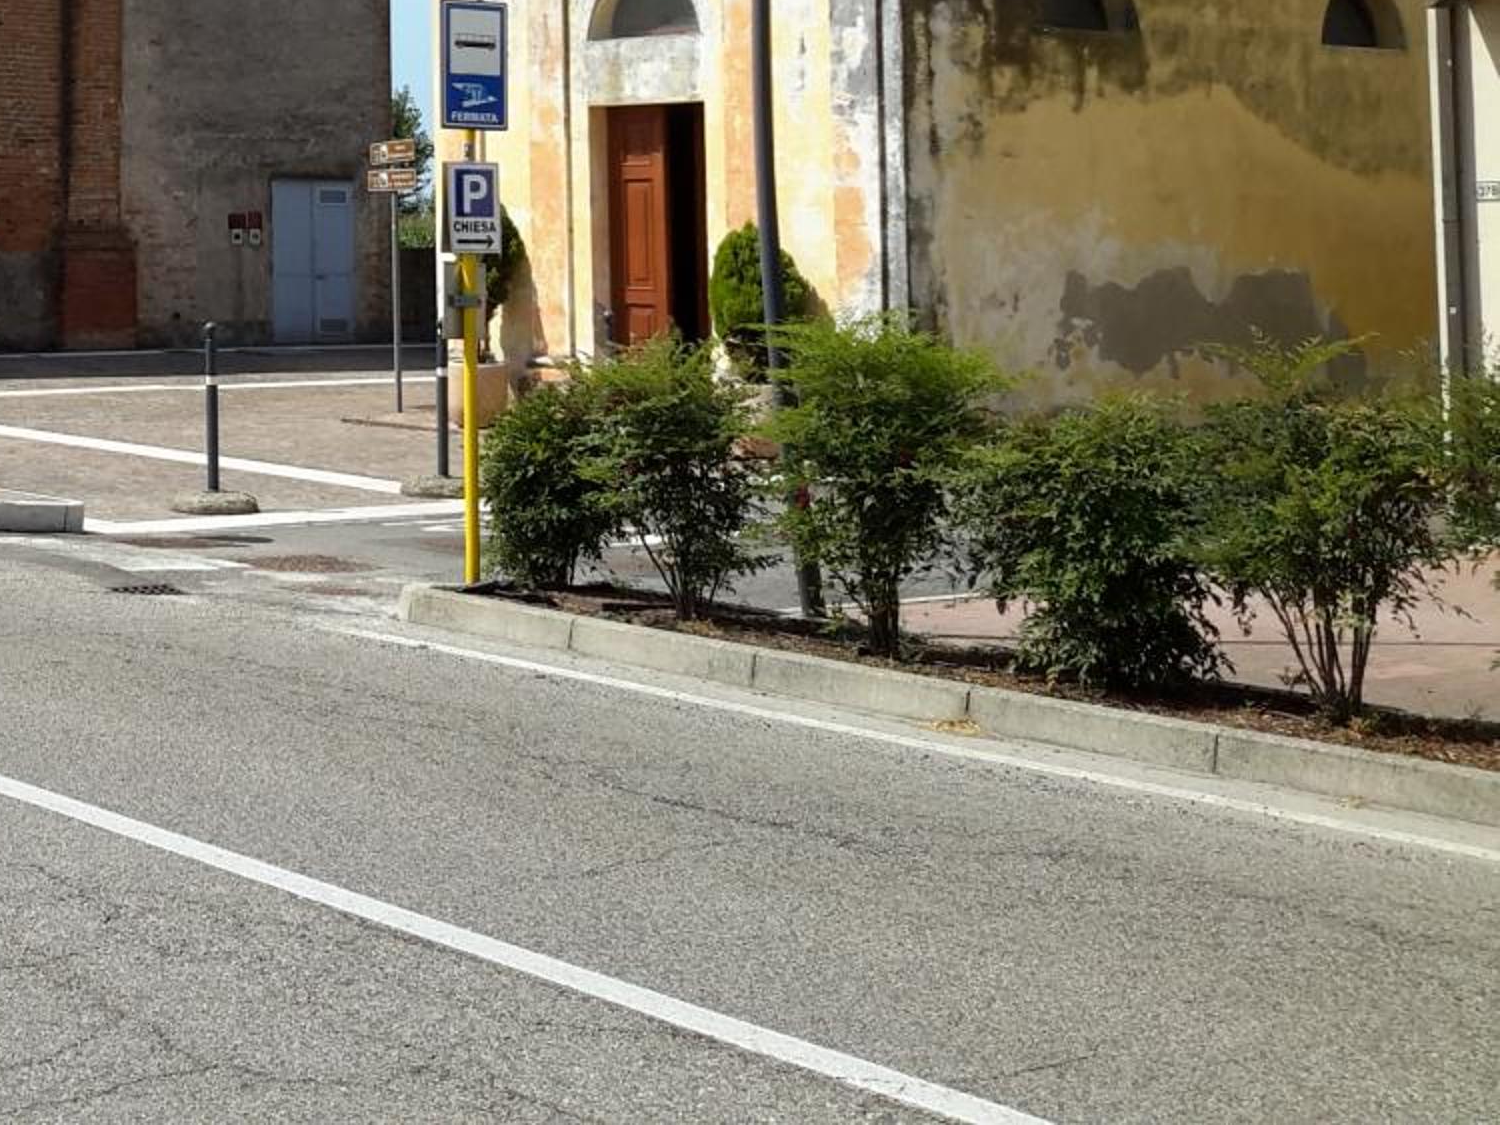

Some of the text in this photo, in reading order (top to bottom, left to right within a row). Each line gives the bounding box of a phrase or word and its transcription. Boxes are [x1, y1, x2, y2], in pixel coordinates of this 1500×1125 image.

[451, 111, 499, 123] FERMATA
[463, 174, 487, 213] P
[453, 220, 496, 233] CHIESA
